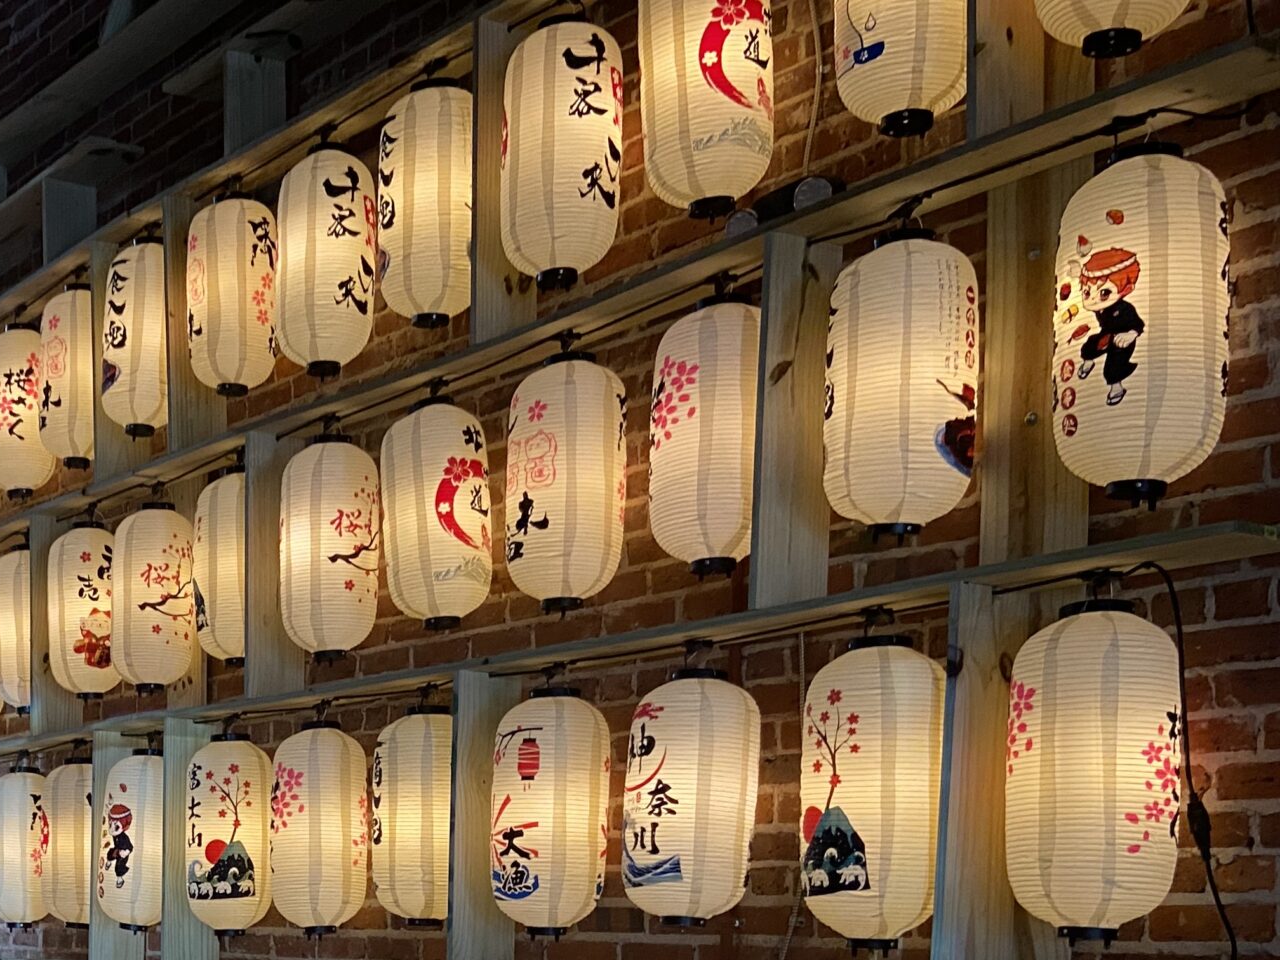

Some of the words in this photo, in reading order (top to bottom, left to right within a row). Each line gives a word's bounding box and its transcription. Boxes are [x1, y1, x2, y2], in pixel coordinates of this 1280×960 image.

[330, 508, 362, 537] 桜
[139, 562, 170, 589] 桜
[628, 722, 679, 855] 神奈川
[499, 827, 533, 894] 大漁
